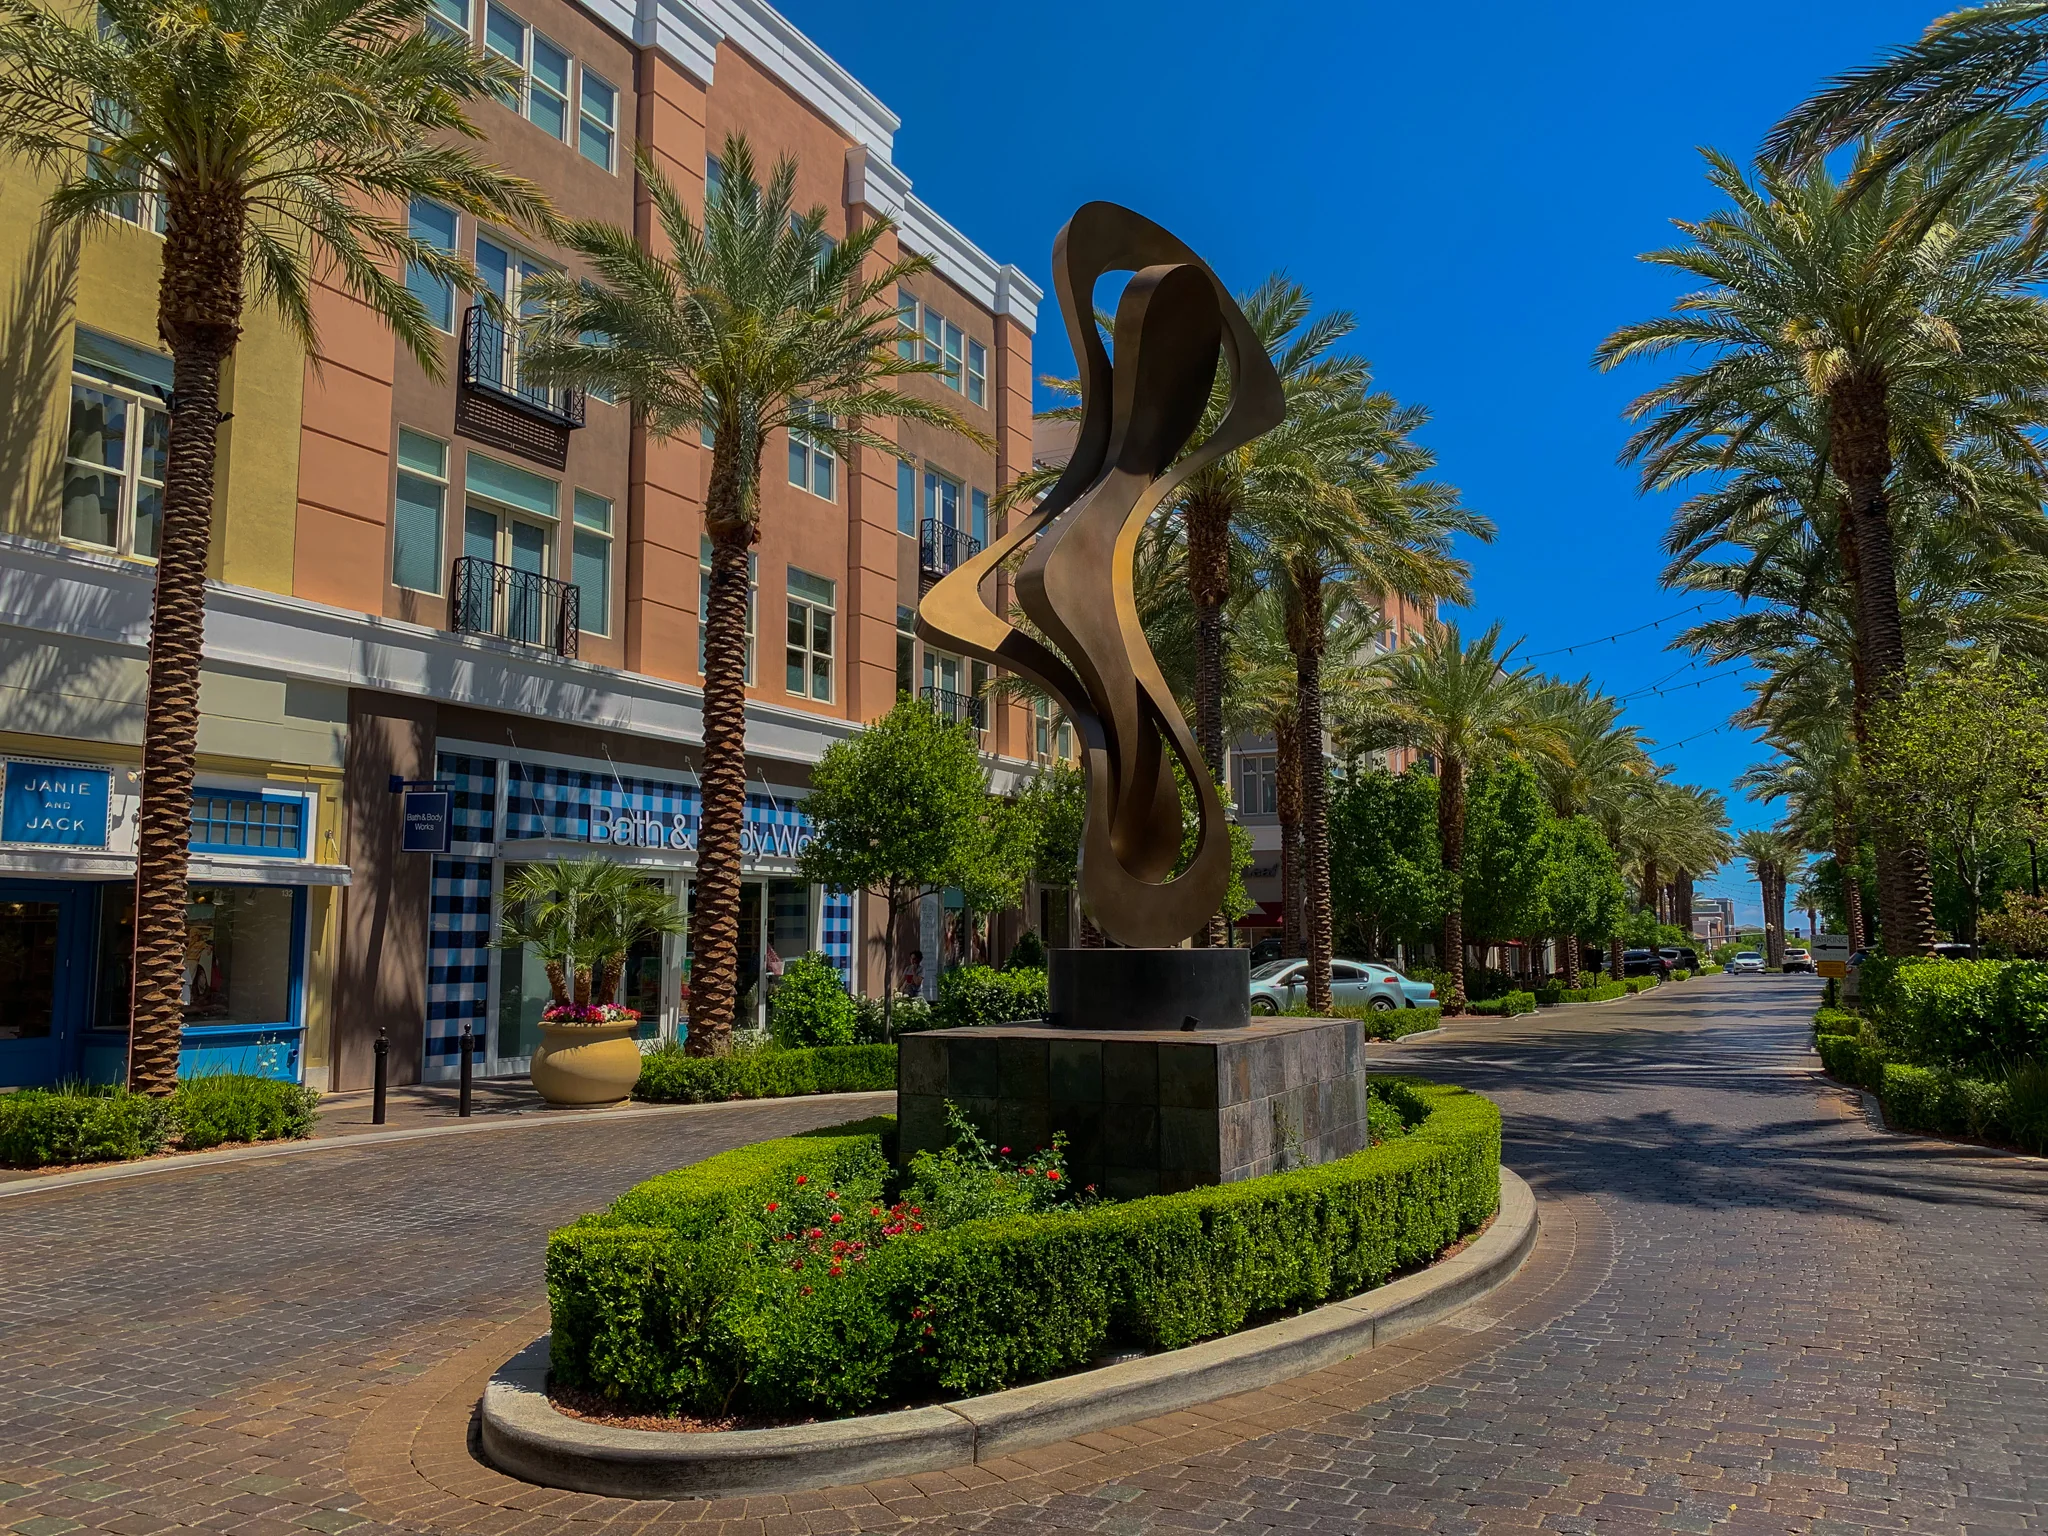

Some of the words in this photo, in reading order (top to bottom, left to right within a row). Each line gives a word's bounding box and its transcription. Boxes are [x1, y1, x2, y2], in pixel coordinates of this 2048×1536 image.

[24, 779, 91, 795] JANIE
[44, 801, 71, 810] AND
[26, 816, 85, 831] JACK
[414, 823, 434, 831] Works
[589, 805, 664, 848] Bath
[670, 813, 697, 851] &
[281, 889, 293, 898] 132
[1811, 936, 1848, 944] PARKING
